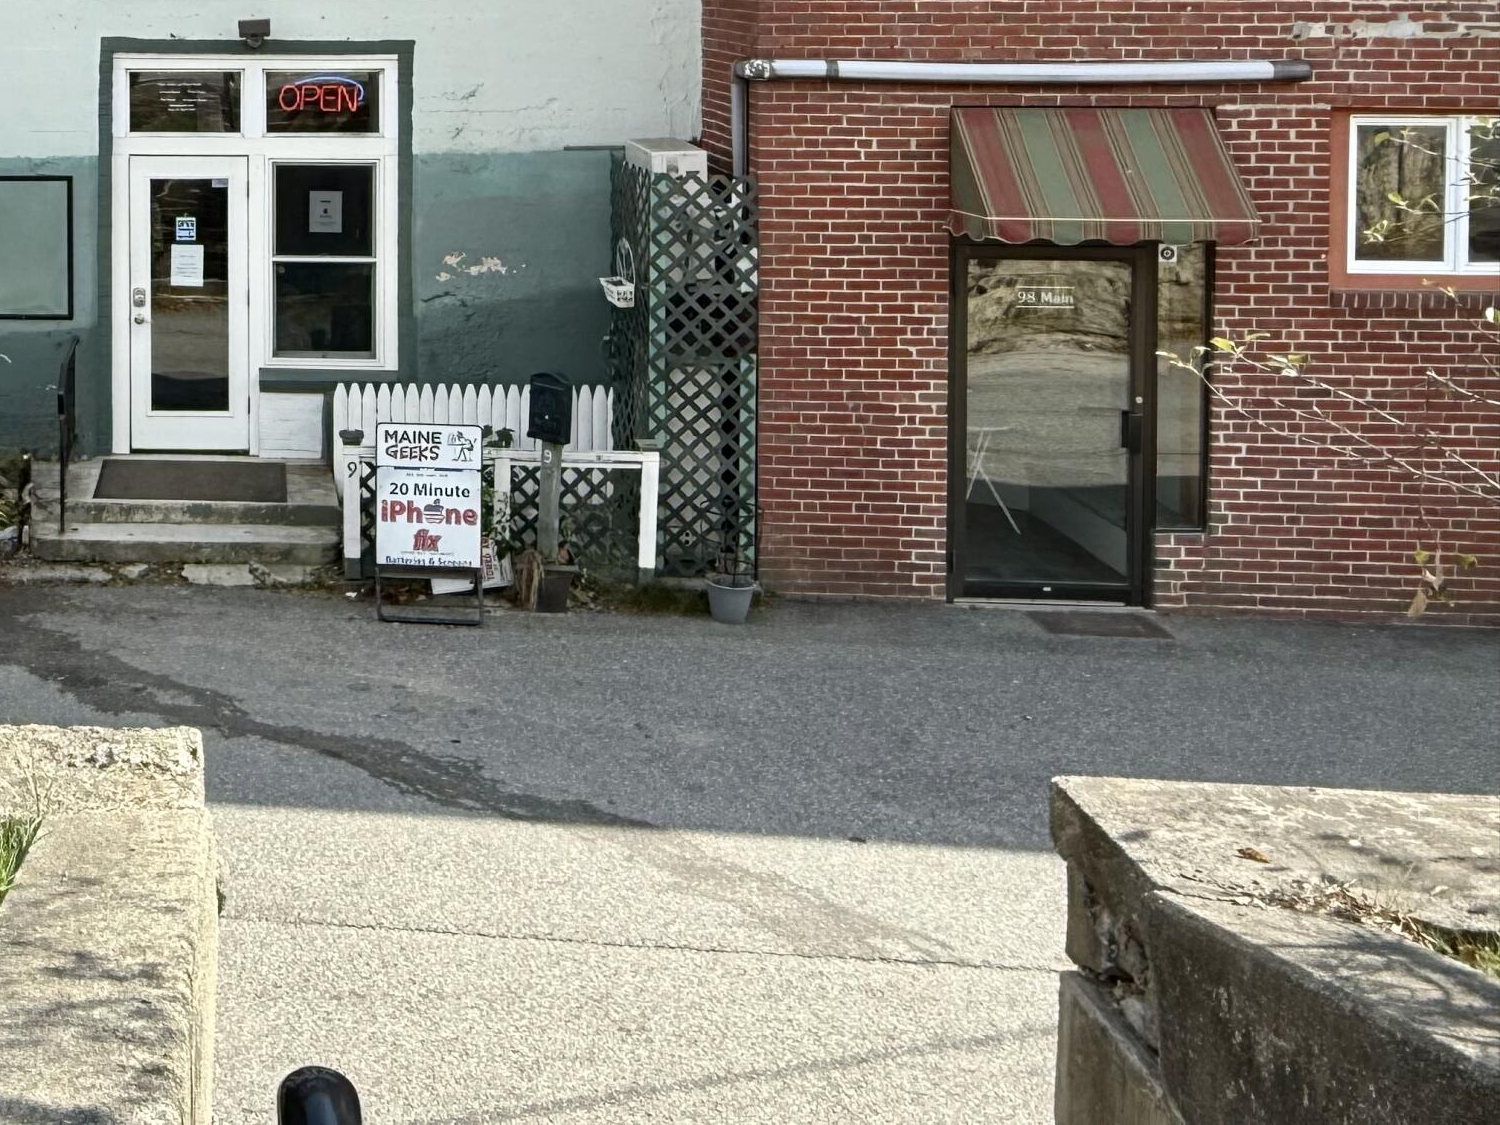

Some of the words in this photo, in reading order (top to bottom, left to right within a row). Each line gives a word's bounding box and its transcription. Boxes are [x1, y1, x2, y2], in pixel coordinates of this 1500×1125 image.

[278, 83, 358, 112] OPEN
[1017, 291, 1036, 303] 98
[1041, 291, 1074, 304] Main
[384, 429, 443, 445] MAINE
[385, 444, 441, 462] GEEKS
[543, 449, 552, 463] 9
[348, 462, 357, 478] 9
[389, 482, 409, 496] 20
[413, 482, 470, 498] Minute
[413, 528, 442, 551] fix
